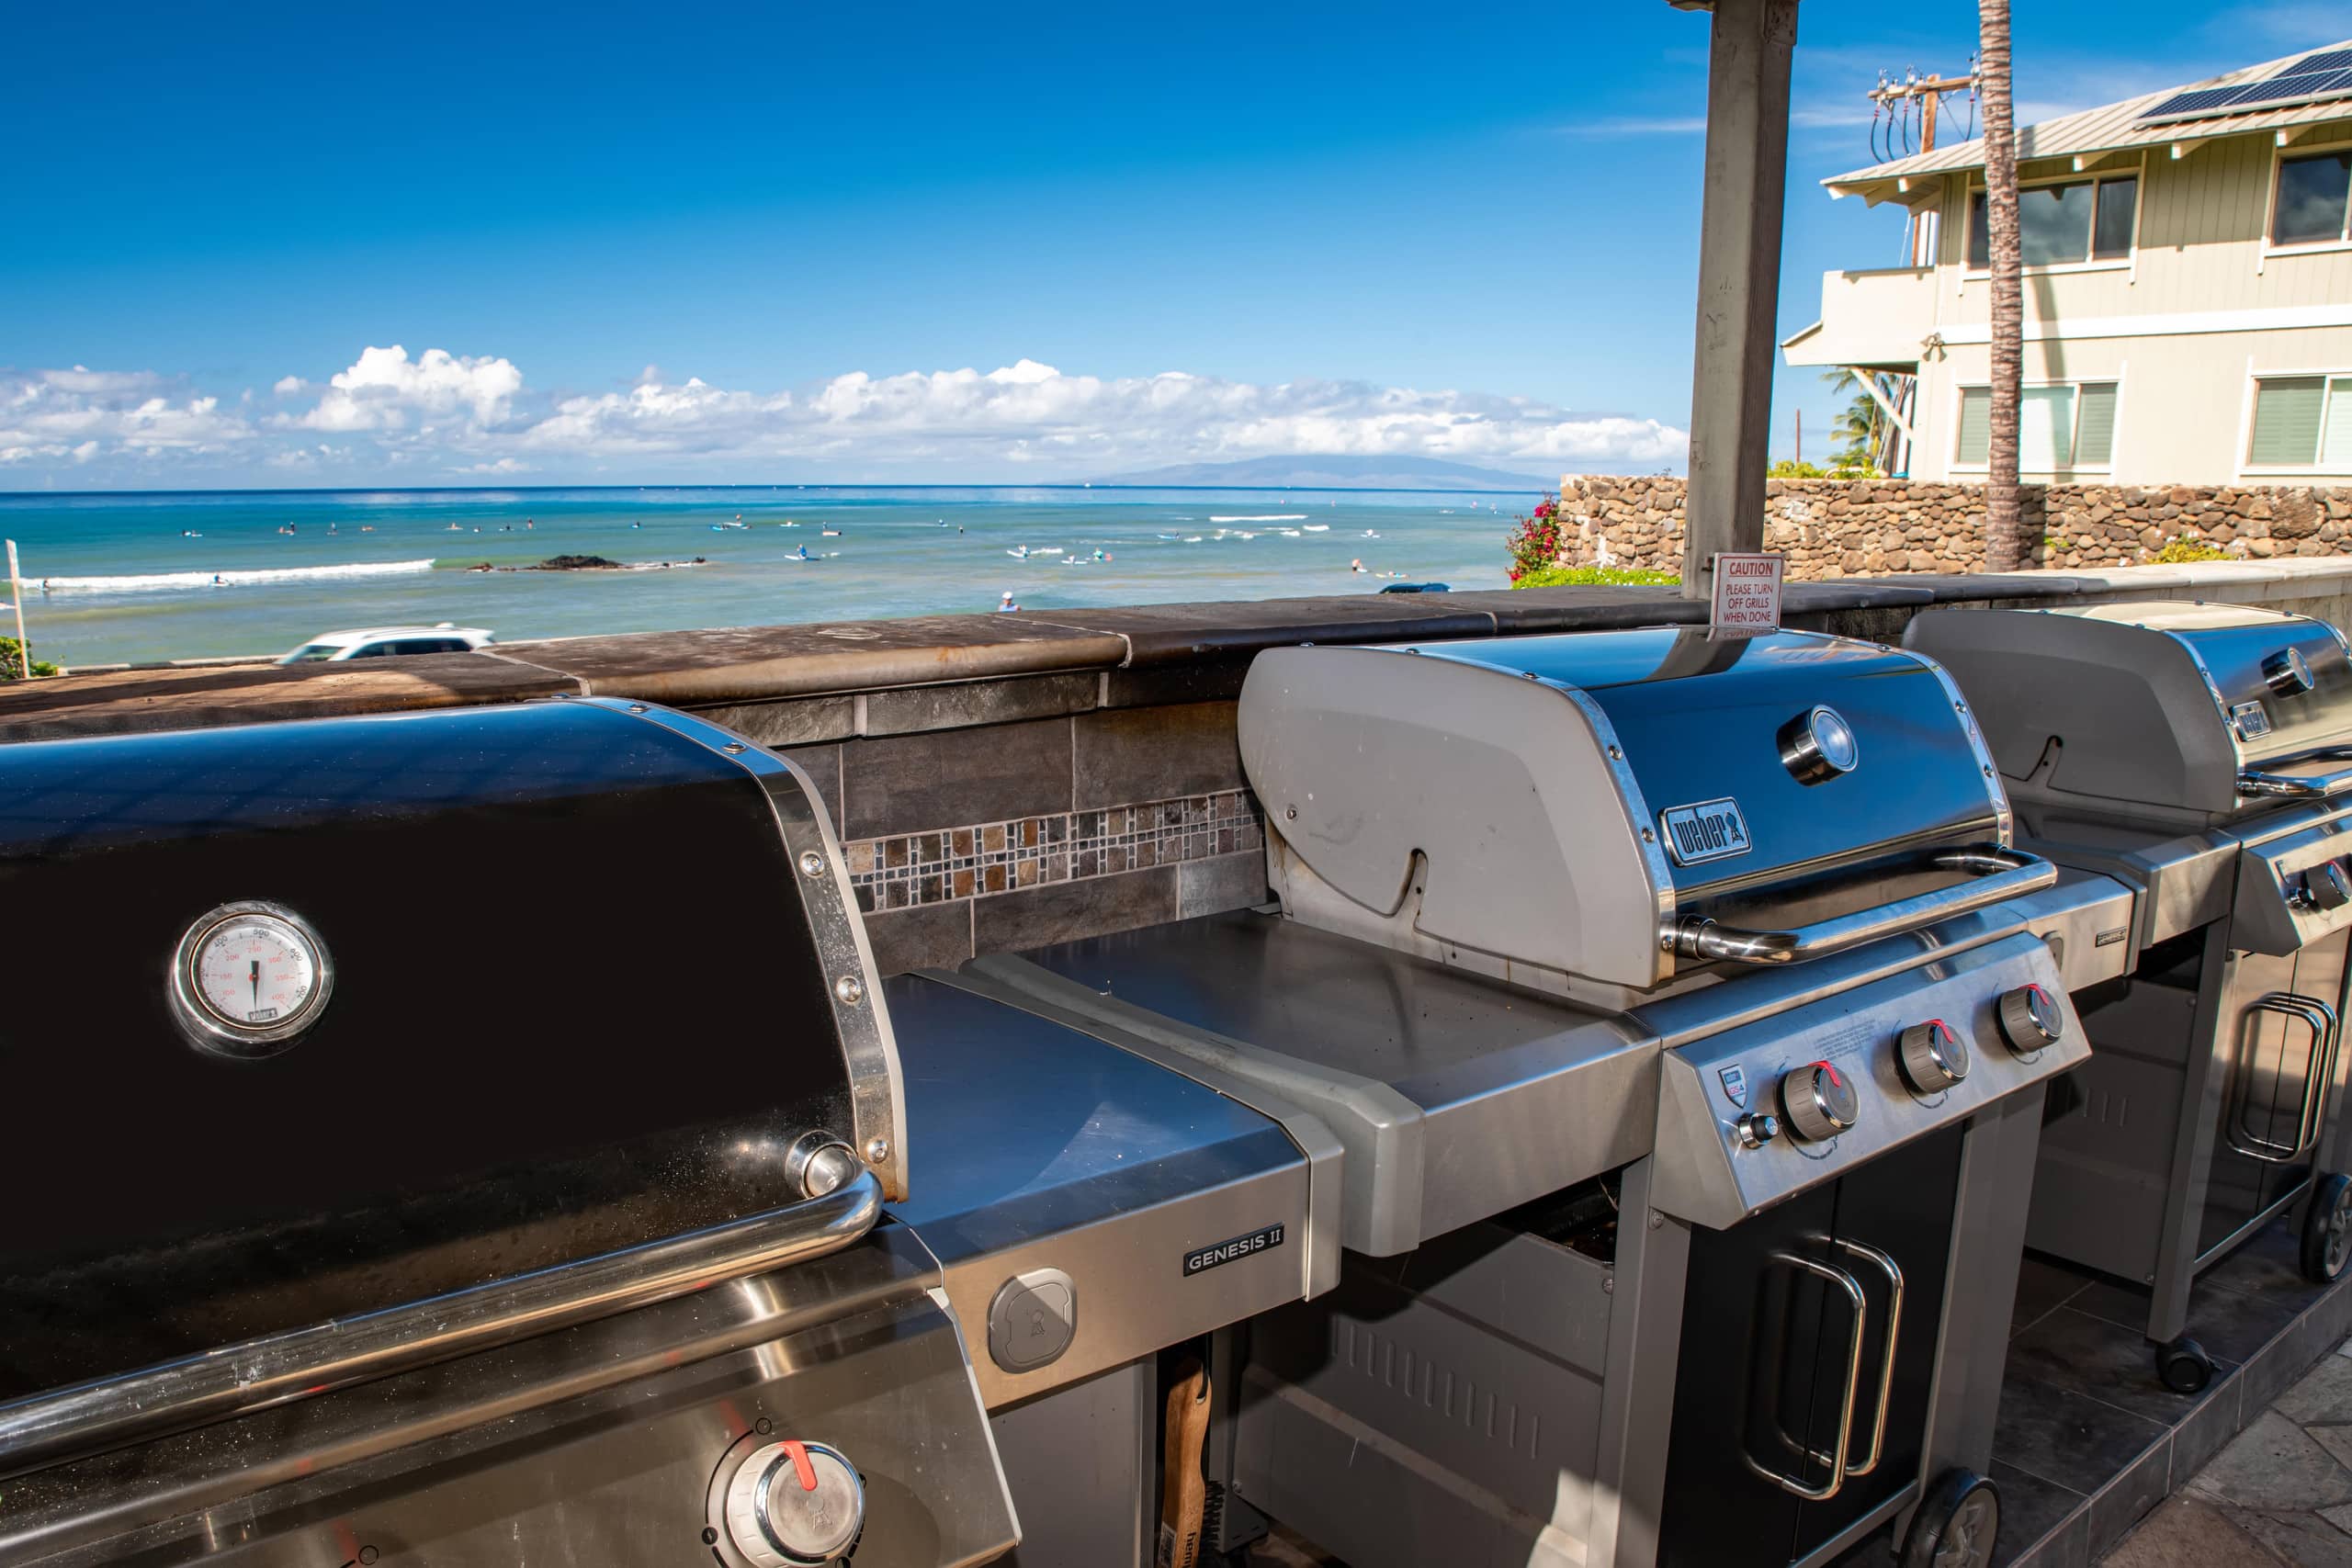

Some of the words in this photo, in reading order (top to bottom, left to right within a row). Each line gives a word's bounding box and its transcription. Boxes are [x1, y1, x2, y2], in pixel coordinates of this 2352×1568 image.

[1729, 562, 1773, 575] CAUTION
[1725, 583, 1752, 595] PLEASE
[1754, 583, 1773, 595] TURN
[1727, 598, 1744, 609] OFF
[1745, 597, 1770, 608] GRILLS
[1724, 612, 1747, 623] WHEN
[1748, 611, 1772, 622] DONE
[1673, 807, 1728, 854] weber
[253, 929, 270, 937] 500
[290, 948, 303, 962] 600
[298, 985, 308, 1000] 700
[1189, 1235, 1265, 1270] GENESIS
[1270, 1229, 1281, 1244] II
